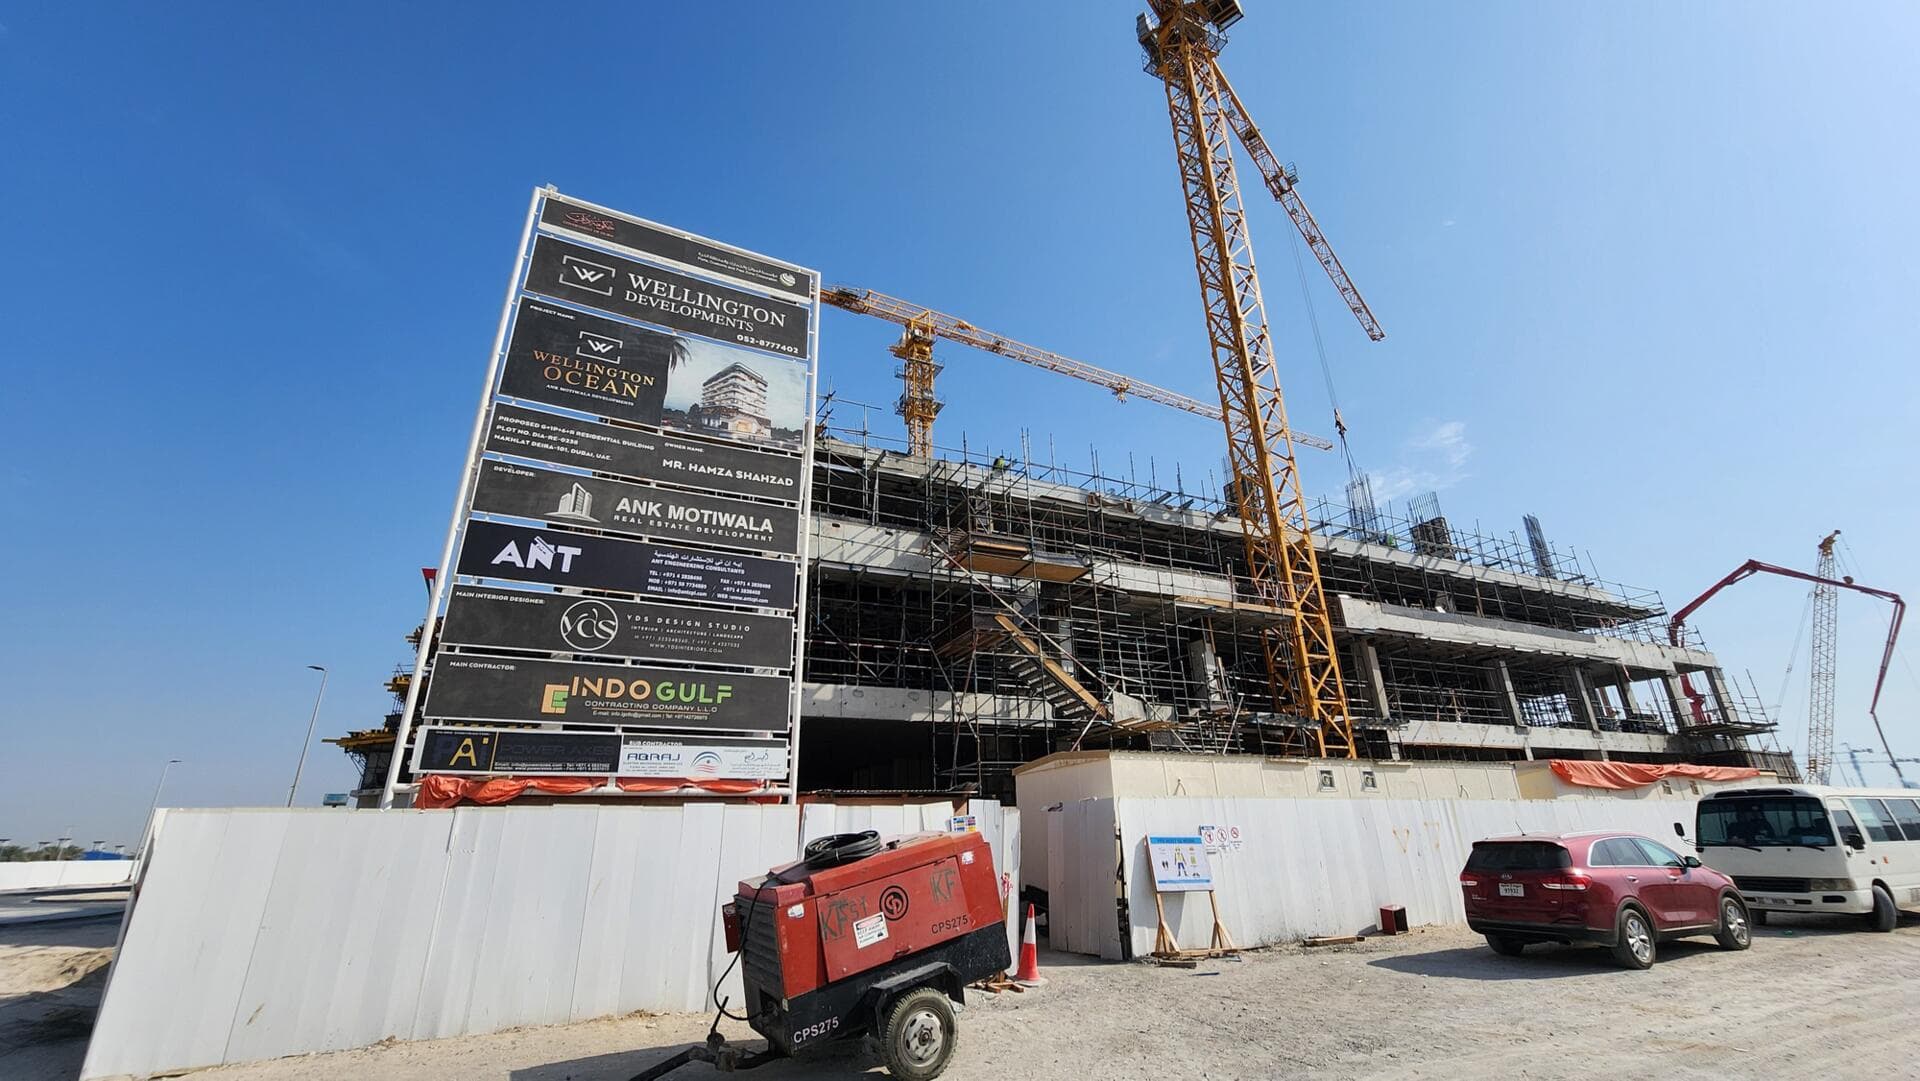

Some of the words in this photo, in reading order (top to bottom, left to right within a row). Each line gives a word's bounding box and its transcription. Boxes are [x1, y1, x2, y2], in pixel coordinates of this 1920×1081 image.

[529, 305, 557, 316] PROJECT
[627, 273, 787, 328] WELLINGTON
[624, 290, 754, 333] DEVELOPMENTS
[736, 334, 799, 354] 052-8777402
[533, 350, 656, 386] WELLINGTON
[543, 366, 641, 399] OCEAN
[560, 387, 591, 398] MOTIWALA
[592, 393, 635, 407] DEVELOPMENTS
[496, 424, 517, 434] PLOT
[498, 415, 540, 428] PROPOSED
[576, 431, 621, 445] RESIDENTIAL
[622, 440, 655, 451] BUILDING
[494, 434, 530, 446] NAKHLAT
[570, 448, 596, 459] DUBAI,
[664, 442, 686, 450] OWNER
[493, 466, 536, 478] DEVELOPER:
[662, 458, 686, 470] MR.
[688, 463, 733, 478] HAMZA
[736, 470, 794, 487] SHAHZAD
[616, 498, 663, 518] ANK
[668, 505, 774, 534] MOTIWALA
[614, 514, 643, 525] REAL
[650, 520, 691, 532] ESTATE
[696, 526, 773, 542] DEVELOPMENT
[491, 536, 582, 573] ANT
[664, 560, 704, 570] ENGINEERING
[704, 564, 745, 575] CONSULTANTS
[475, 592, 509, 601] INTERIOR
[510, 595, 545, 605] DESIGNER:
[627, 614, 649, 622] YDS
[656, 617, 700, 628] DESIGN
[708, 622, 750, 632] STUDIO
[666, 628, 707, 636] ARCHITECTURE
[712, 632, 744, 640] LANDSCAPE
[468, 662, 516, 671] CONTRACTOR:
[584, 700, 650, 710] CONTRACTING
[652, 704, 696, 712] COMPANY
[931, 914, 968, 934] CPS275
[793, 1016, 840, 1044] CPS275
